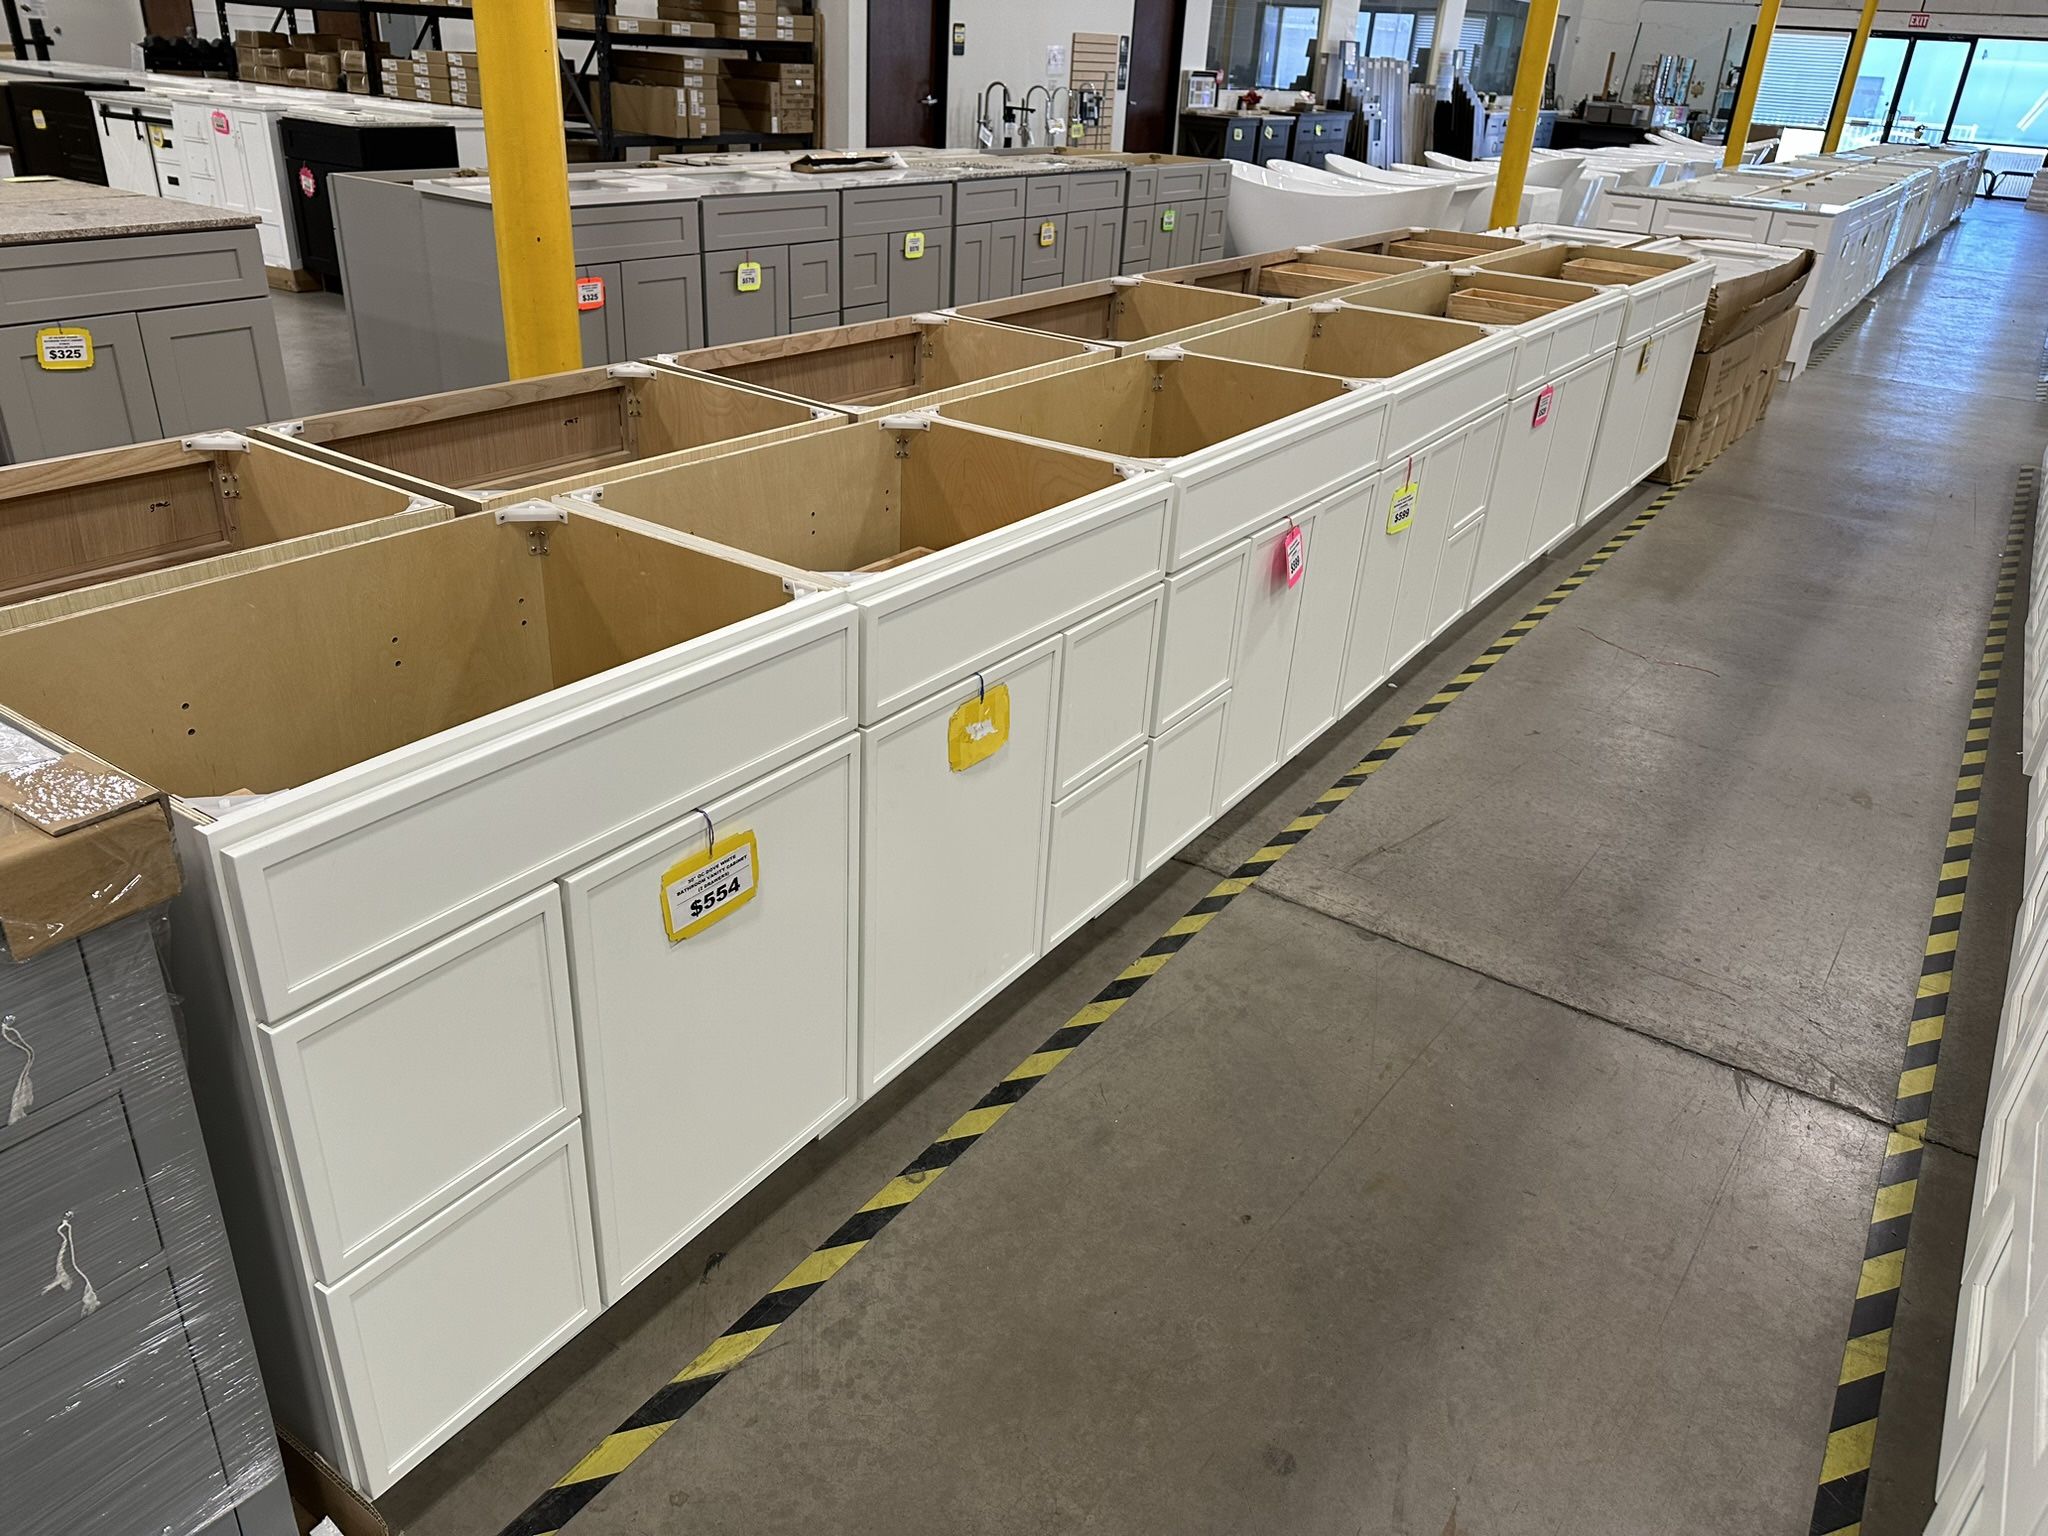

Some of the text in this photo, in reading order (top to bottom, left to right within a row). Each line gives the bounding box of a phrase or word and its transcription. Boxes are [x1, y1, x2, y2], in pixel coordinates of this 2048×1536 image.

[1909, 16, 1929, 26] EXIT
[582, 293, 599, 302] $325
[49, 349, 82, 360] $325
[720, 854, 737, 866] WHITE
[676, 854, 748, 897] BATHROOM VANITY CABINET
[690, 876, 741, 918] $554
